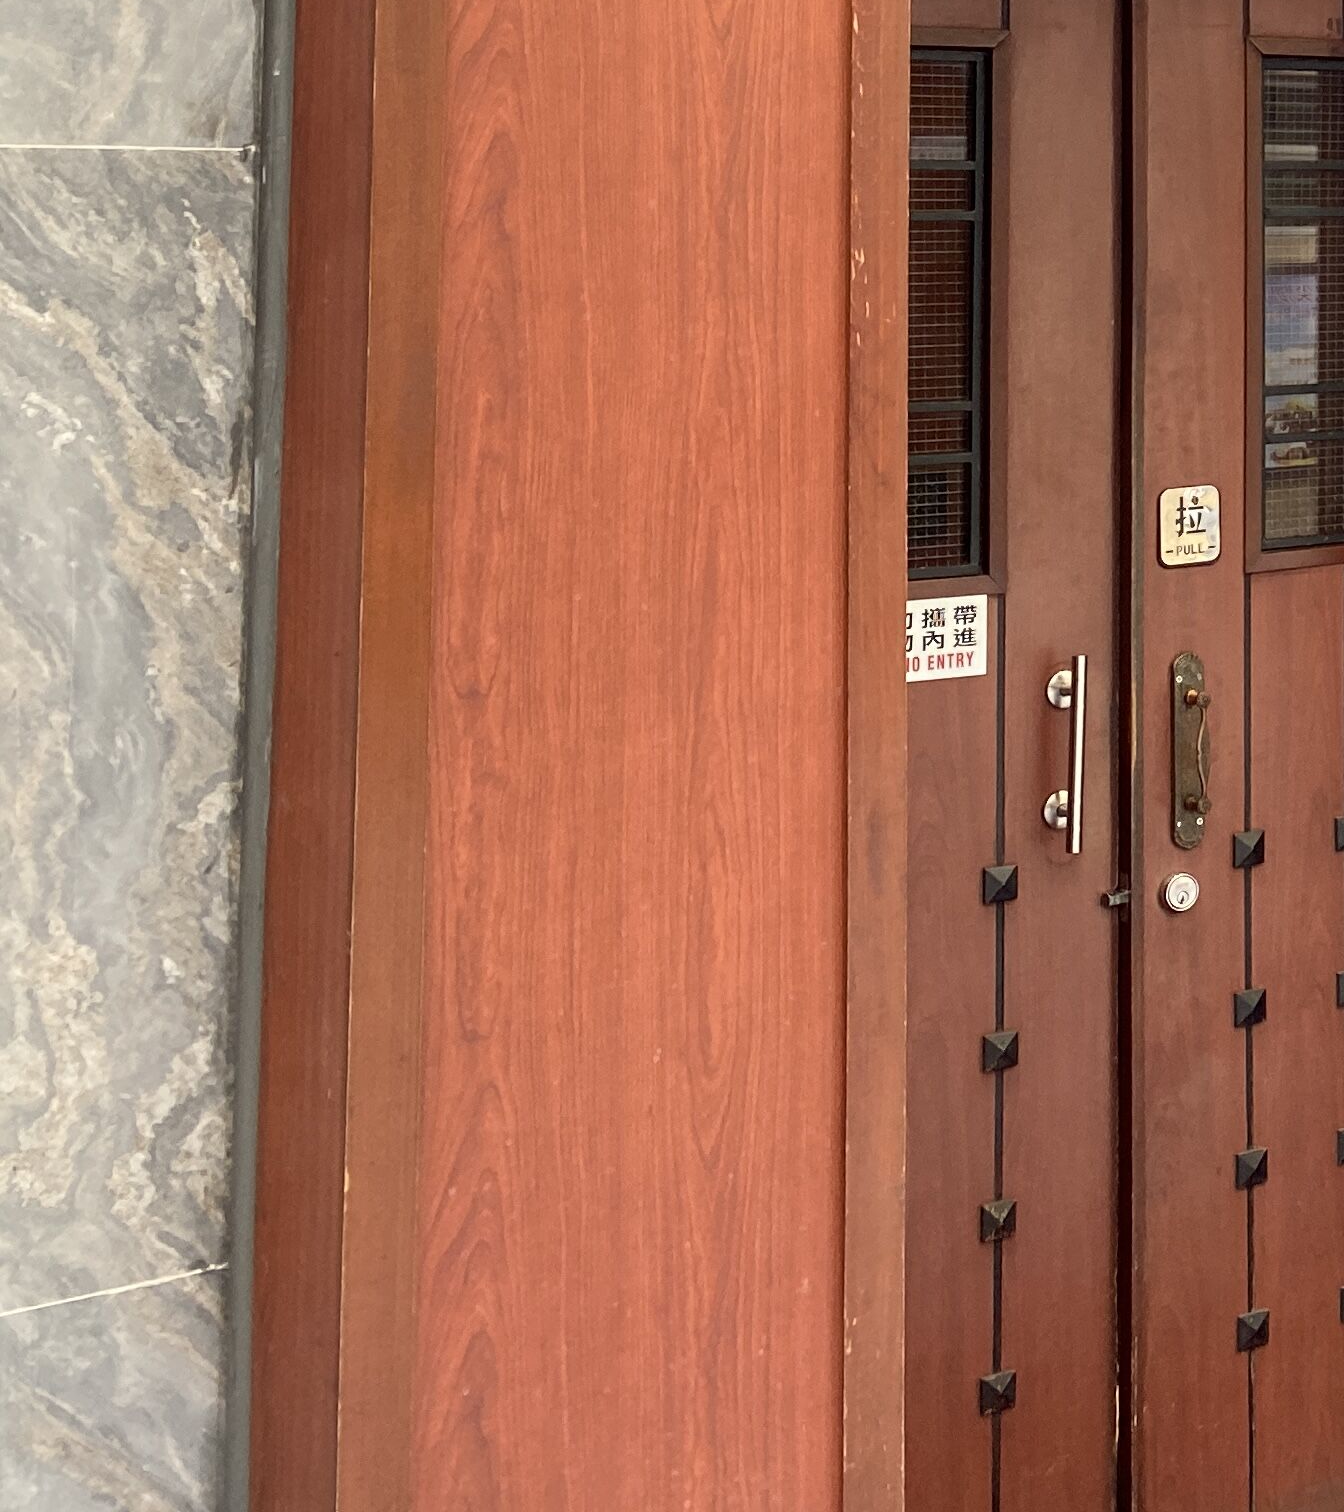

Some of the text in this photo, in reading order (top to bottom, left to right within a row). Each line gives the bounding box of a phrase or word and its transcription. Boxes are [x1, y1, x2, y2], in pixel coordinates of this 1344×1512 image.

[1175, 495, 1207, 538] 拉
[1176, 543, 1206, 556] PULL
[927, 650, 975, 671] ENTRY
